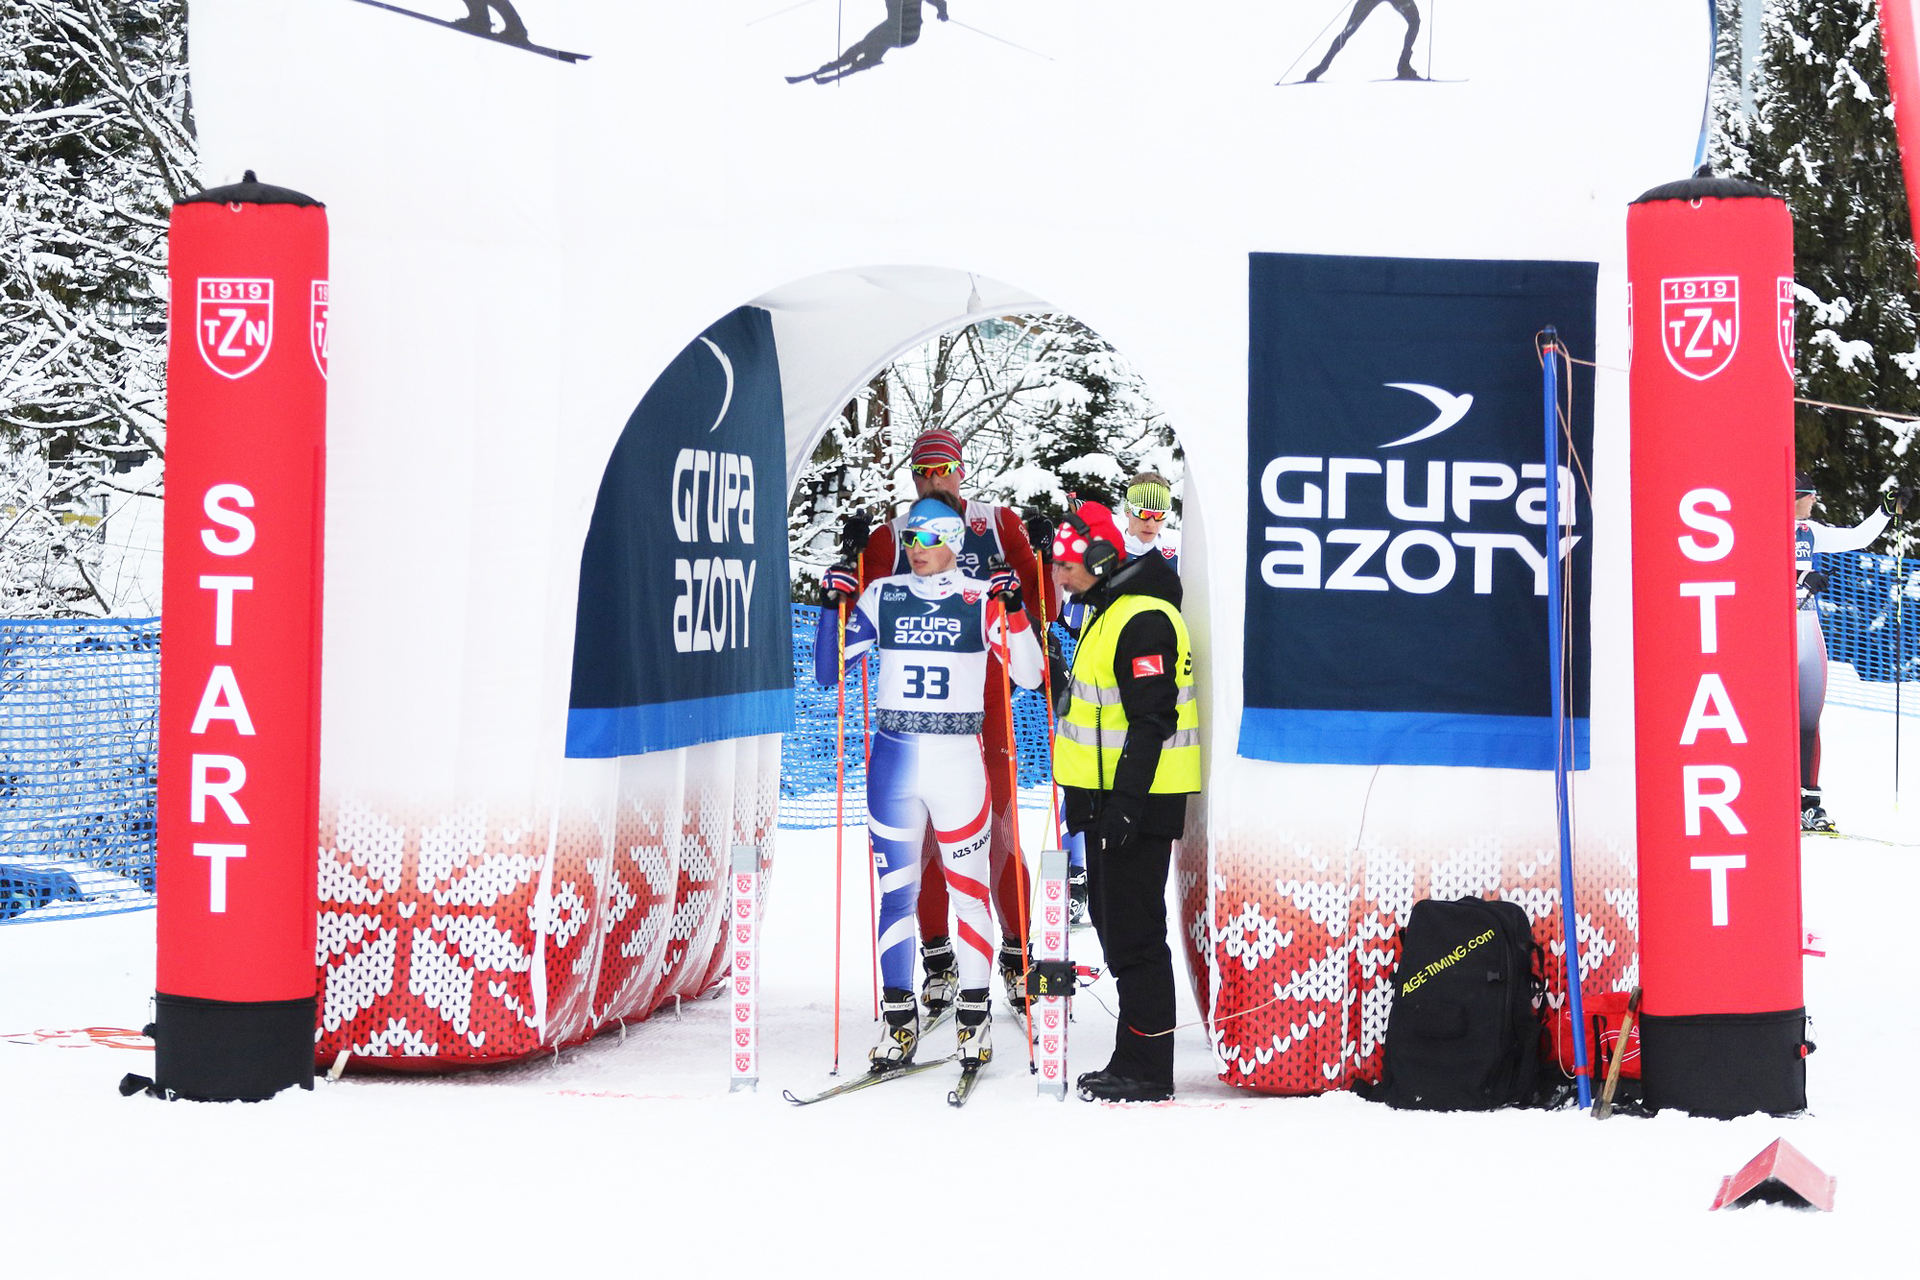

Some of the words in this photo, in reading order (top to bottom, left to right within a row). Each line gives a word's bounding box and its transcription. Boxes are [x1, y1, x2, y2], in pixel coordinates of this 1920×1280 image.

[207, 283, 262, 299] 1919
[1670, 281, 1727, 299] 1919
[204, 308, 265, 357] TZN
[1669, 308, 1732, 357] TZN
[1795, 549, 1811, 557] OTY
[190, 483, 257, 913] START
[903, 665, 950, 700] 33
[1677, 487, 1748, 926] START
[952, 847, 971, 859] AZS
[1402, 928, 1495, 997] ALGE-TIMING.com
